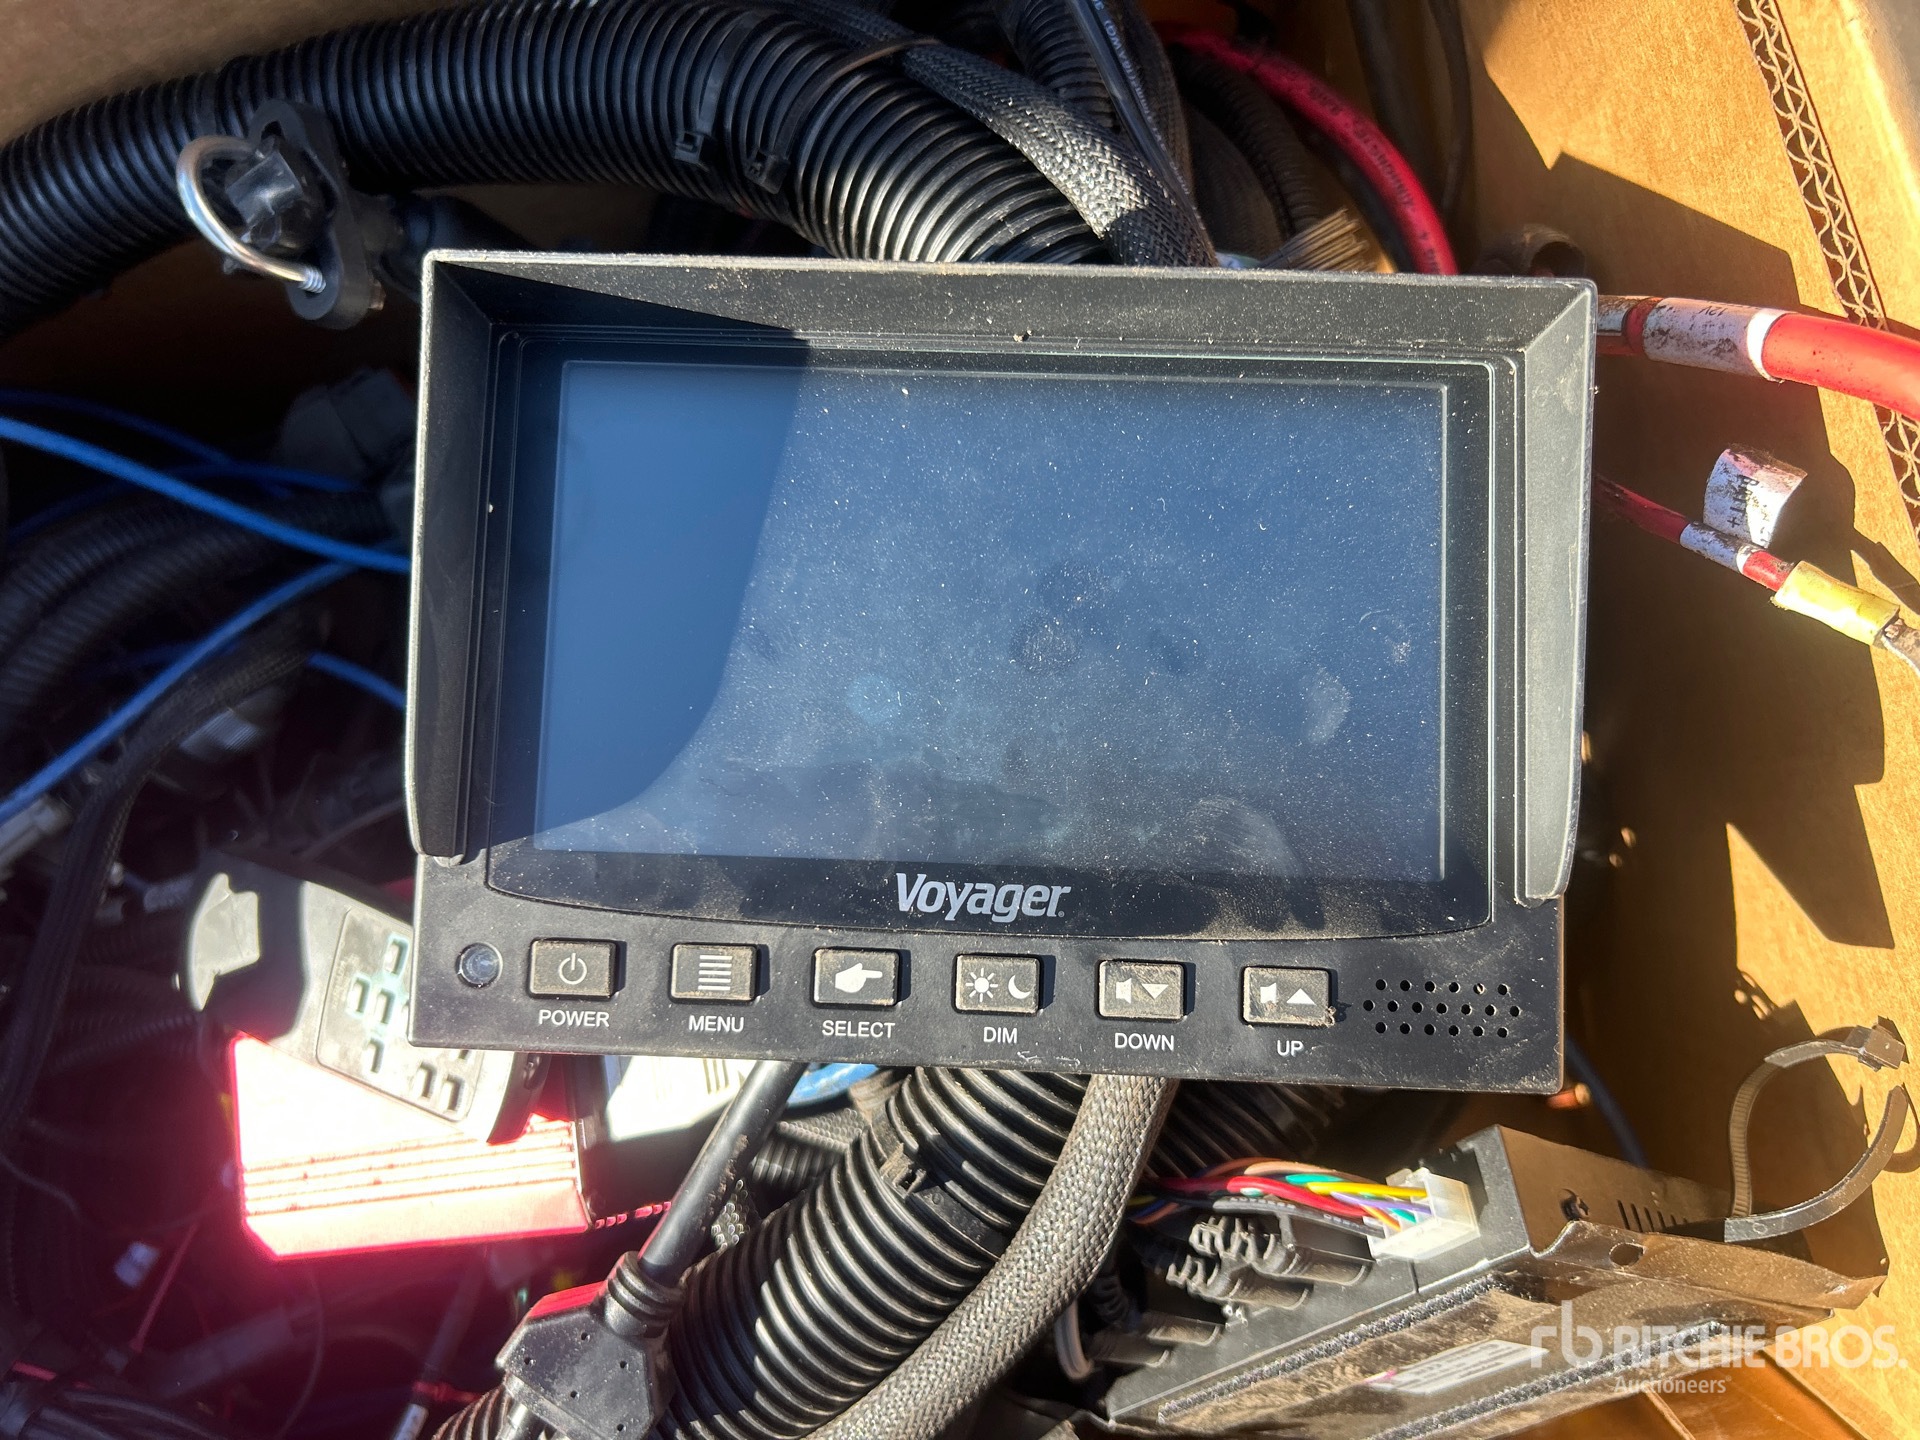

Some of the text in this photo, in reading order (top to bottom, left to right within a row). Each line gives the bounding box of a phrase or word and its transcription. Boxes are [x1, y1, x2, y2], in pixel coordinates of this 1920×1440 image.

[1698, 305, 1727, 317] 12V
[538, 1009, 610, 1028] POWER
[688, 1015, 745, 1033] MENU
[821, 1020, 896, 1039] SELECT
[983, 1026, 1018, 1044] DIM
[1114, 1032, 1175, 1051] DOWN
[1276, 1039, 1304, 1057] UP
